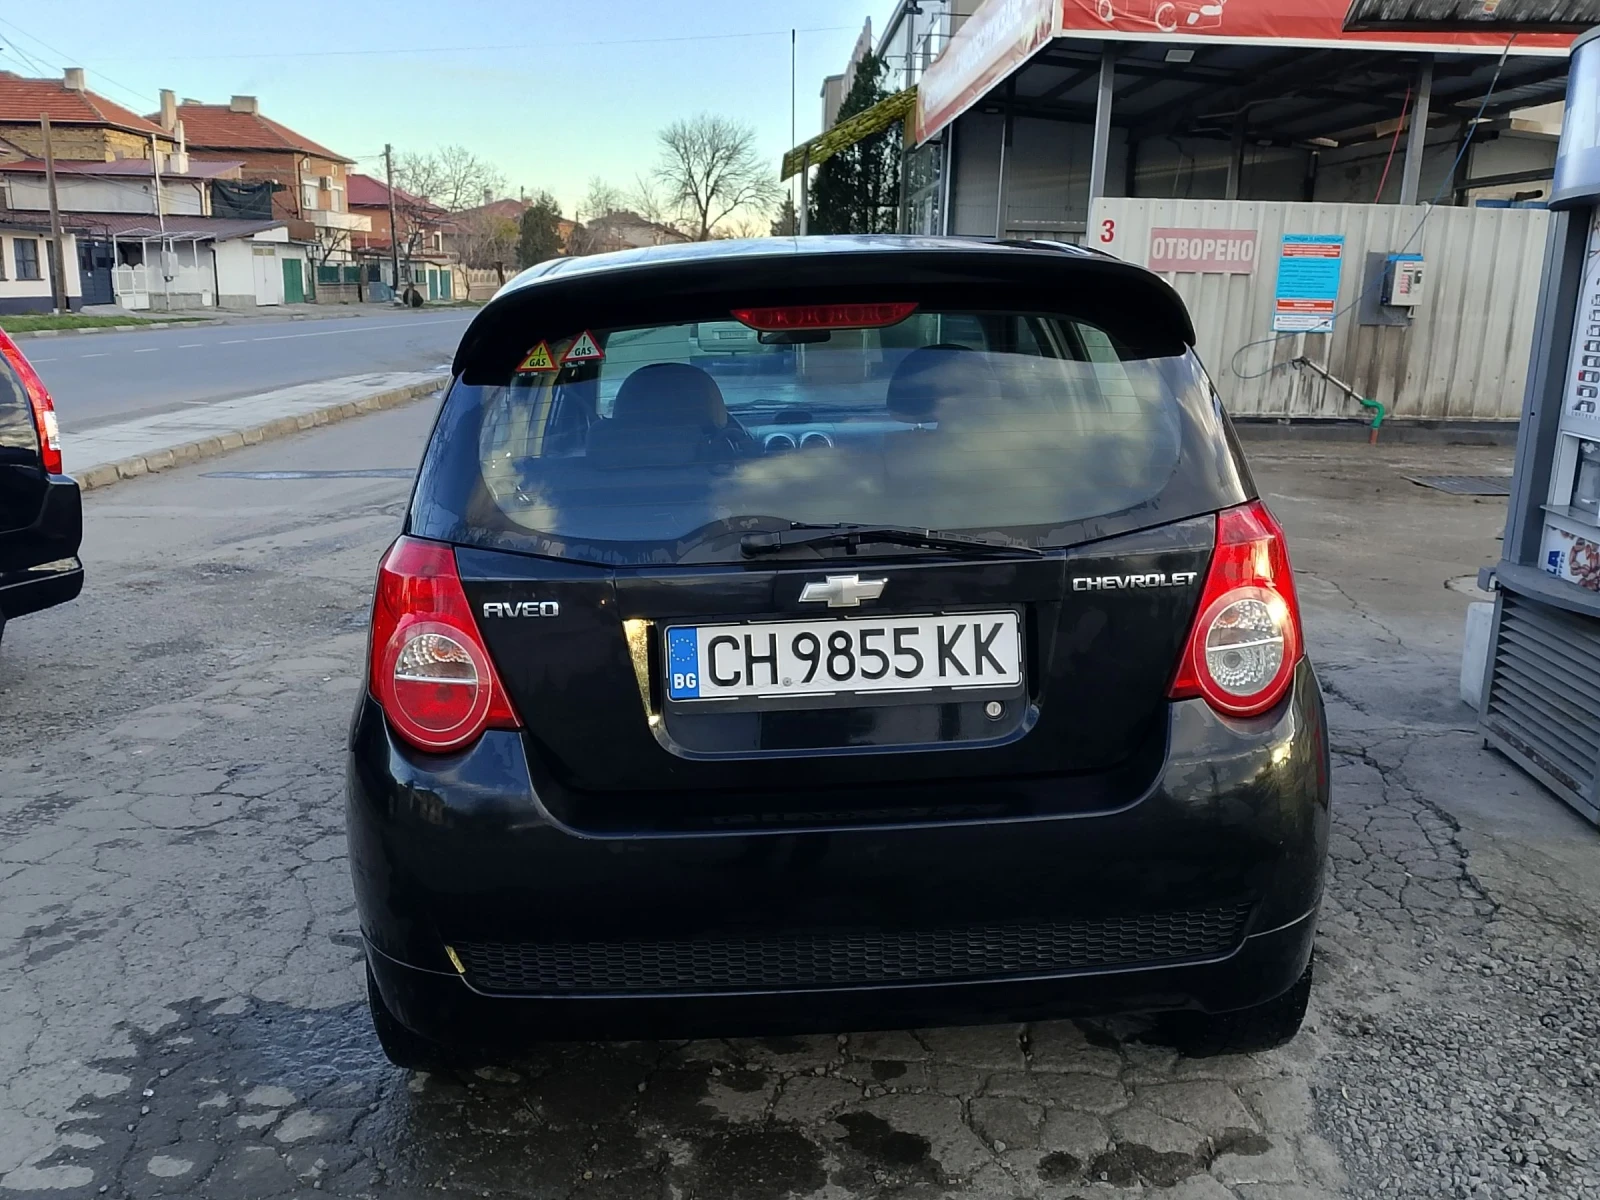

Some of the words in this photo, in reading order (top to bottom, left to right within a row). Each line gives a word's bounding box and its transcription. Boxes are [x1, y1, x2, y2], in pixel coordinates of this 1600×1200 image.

[1100, 219, 1115, 243] 3
[1152, 237, 1254, 262] ОТВОРЕНО
[574, 346, 592, 357] GAS
[529, 358, 546, 367] GAS
[1072, 571, 1198, 591] CHEVROLET
[483, 601, 559, 618] AVEO
[707, 633, 779, 687] CH
[791, 627, 924, 684] 9855
[937, 622, 1007, 678] KK
[673, 672, 697, 689] BG
